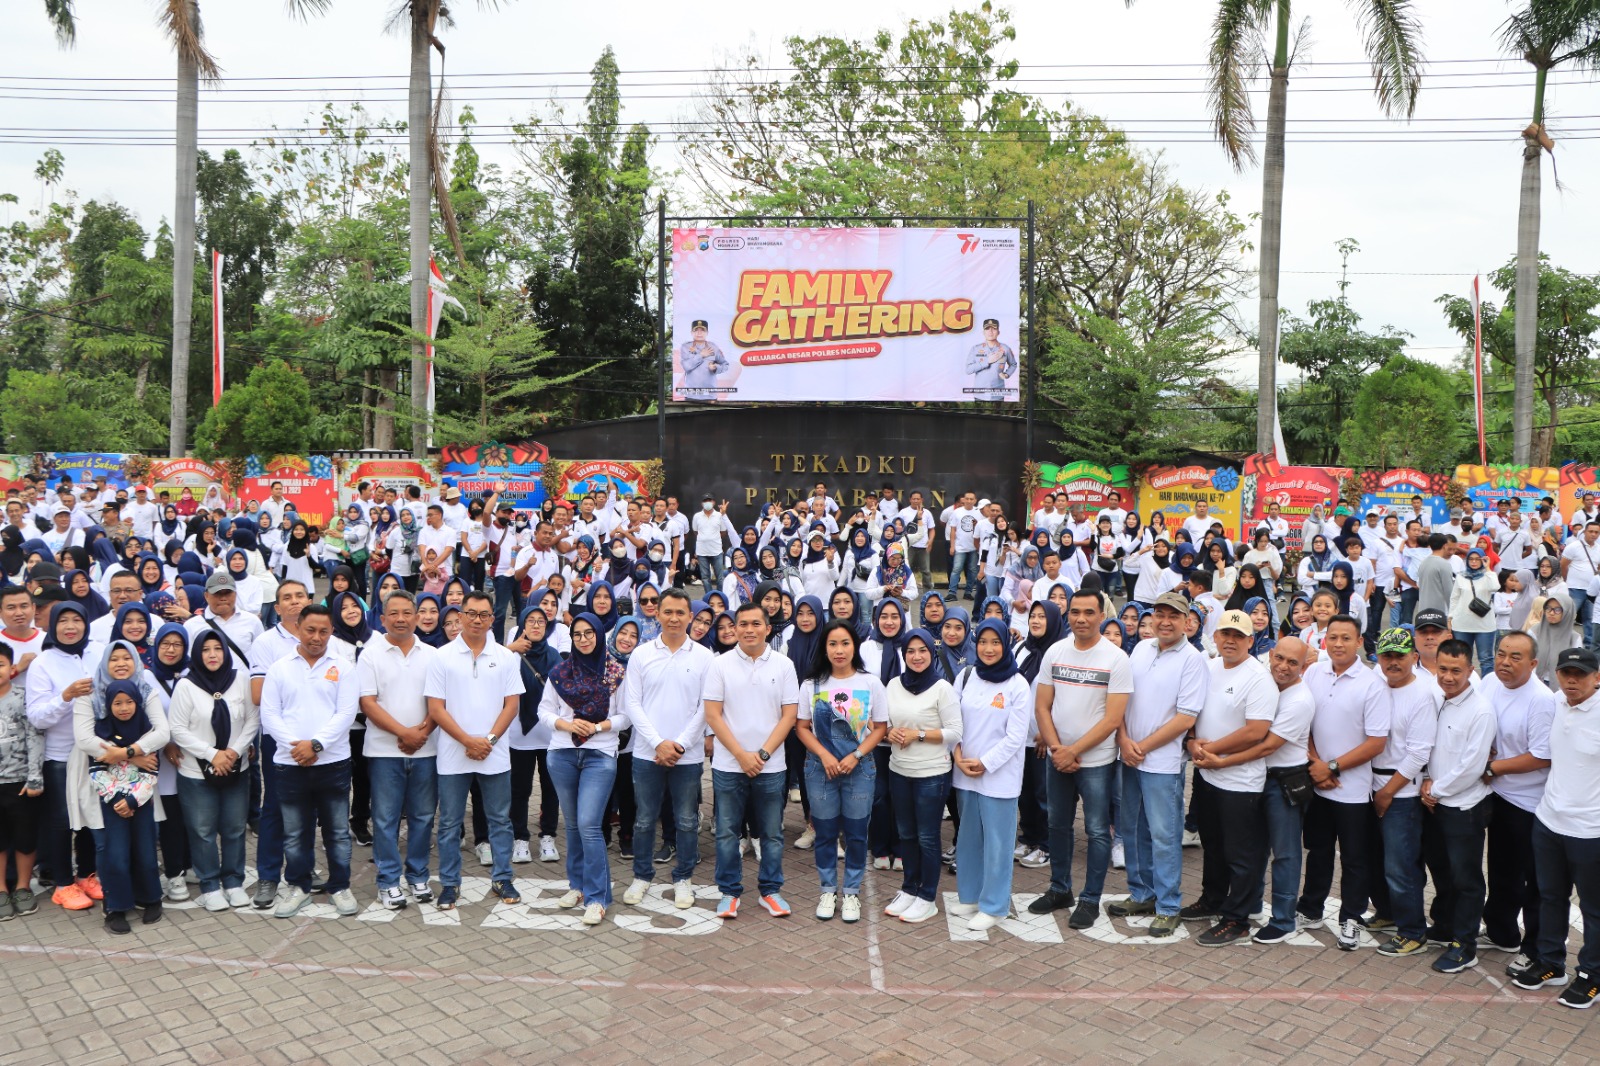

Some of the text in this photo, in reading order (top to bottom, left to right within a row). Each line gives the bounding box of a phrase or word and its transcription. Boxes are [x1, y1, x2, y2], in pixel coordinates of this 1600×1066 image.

[739, 273, 888, 308] FAMILY
[733, 301, 972, 343] GATHERING
[746, 346, 877, 363] KELUARGA BESAR POLRES NGANJUK
[161, 461, 187, 477] SELAMAT
[576, 464, 600, 478] SELAMAT
[608, 464, 629, 479] SUKSES
[770, 454, 916, 475] TEKADKU
[507, 481, 535, 492] ASAD
[1153, 471, 1181, 488] Selamat
[1187, 469, 1210, 480] Sukses
[500, 492, 528, 500] NGANJUK
[1087, 494, 1102, 502] 2023
[1159, 491, 1172, 501] HARI
[1058, 666, 1098, 683] Wrangler
